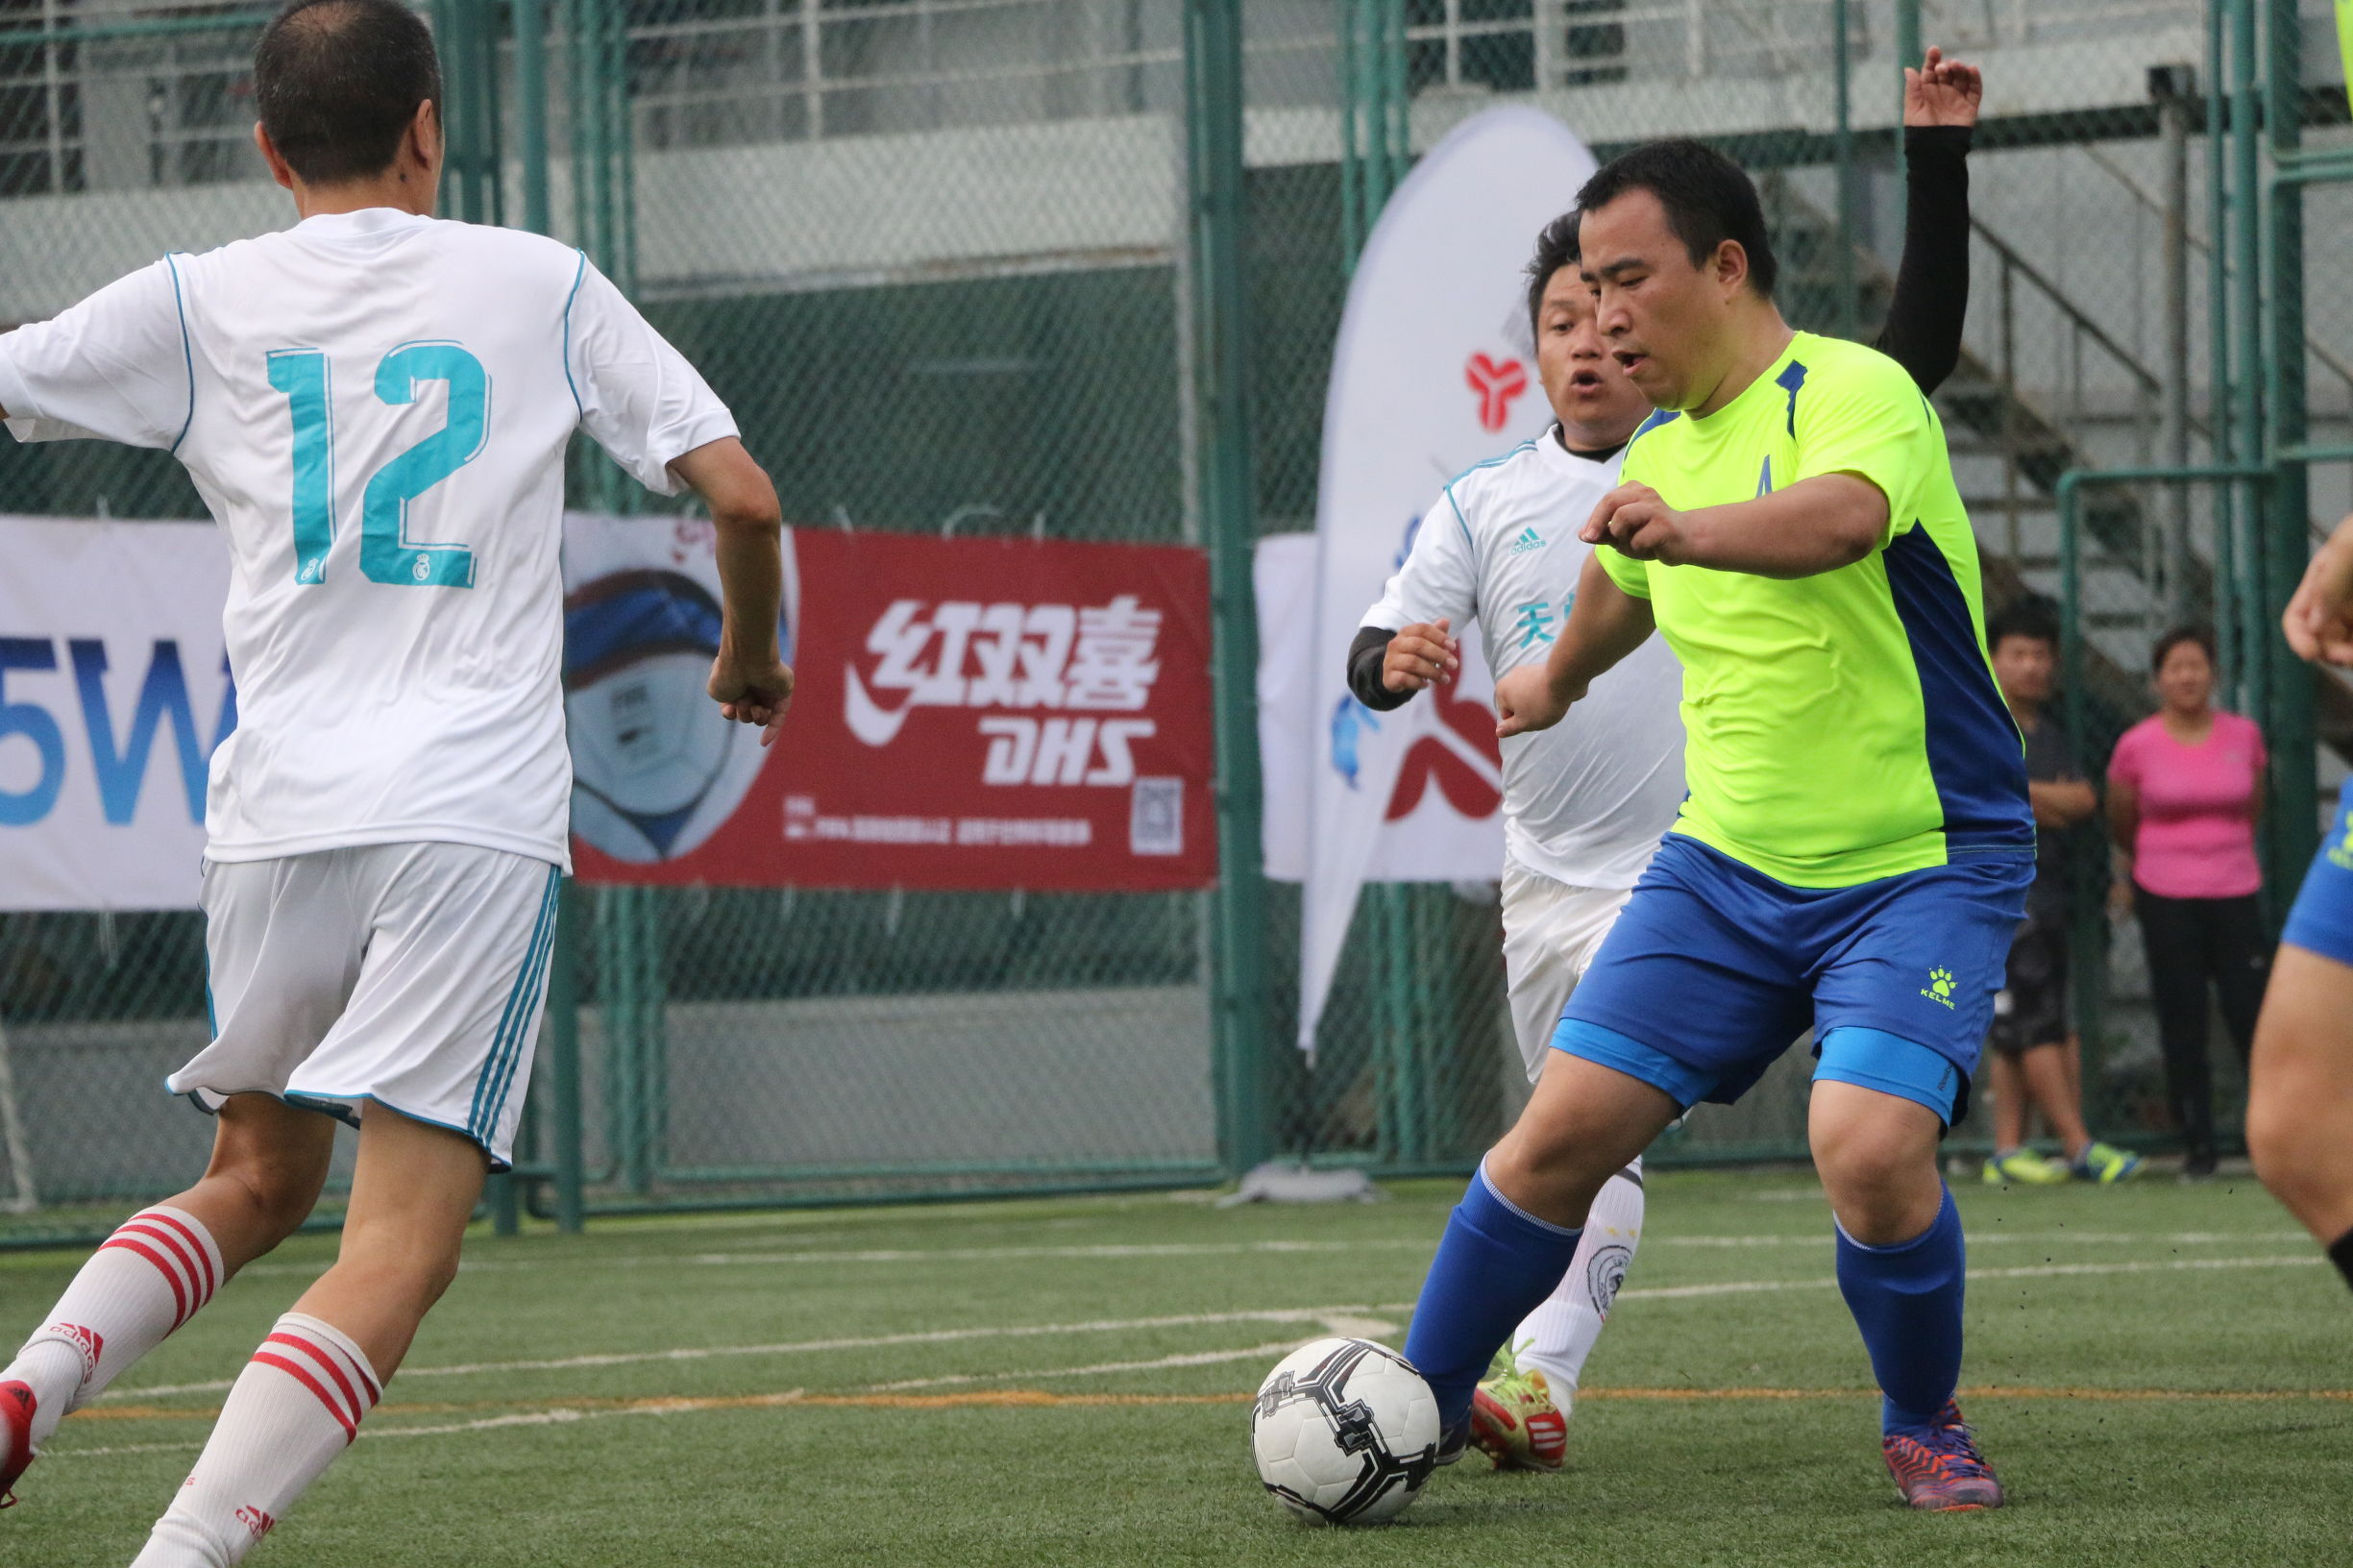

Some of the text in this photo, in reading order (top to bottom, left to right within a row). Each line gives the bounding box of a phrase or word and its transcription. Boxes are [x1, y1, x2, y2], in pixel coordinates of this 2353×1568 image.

[266, 339, 493, 589] 12
[1510, 539, 1547, 556] adidas
[1516, 592, 1576, 649] 天
[864, 594, 1164, 711] 红双喜
[977, 718, 1157, 786] DHS
[1920, 988, 1956, 1011] KELME
[49, 1326, 93, 1384] adidas
